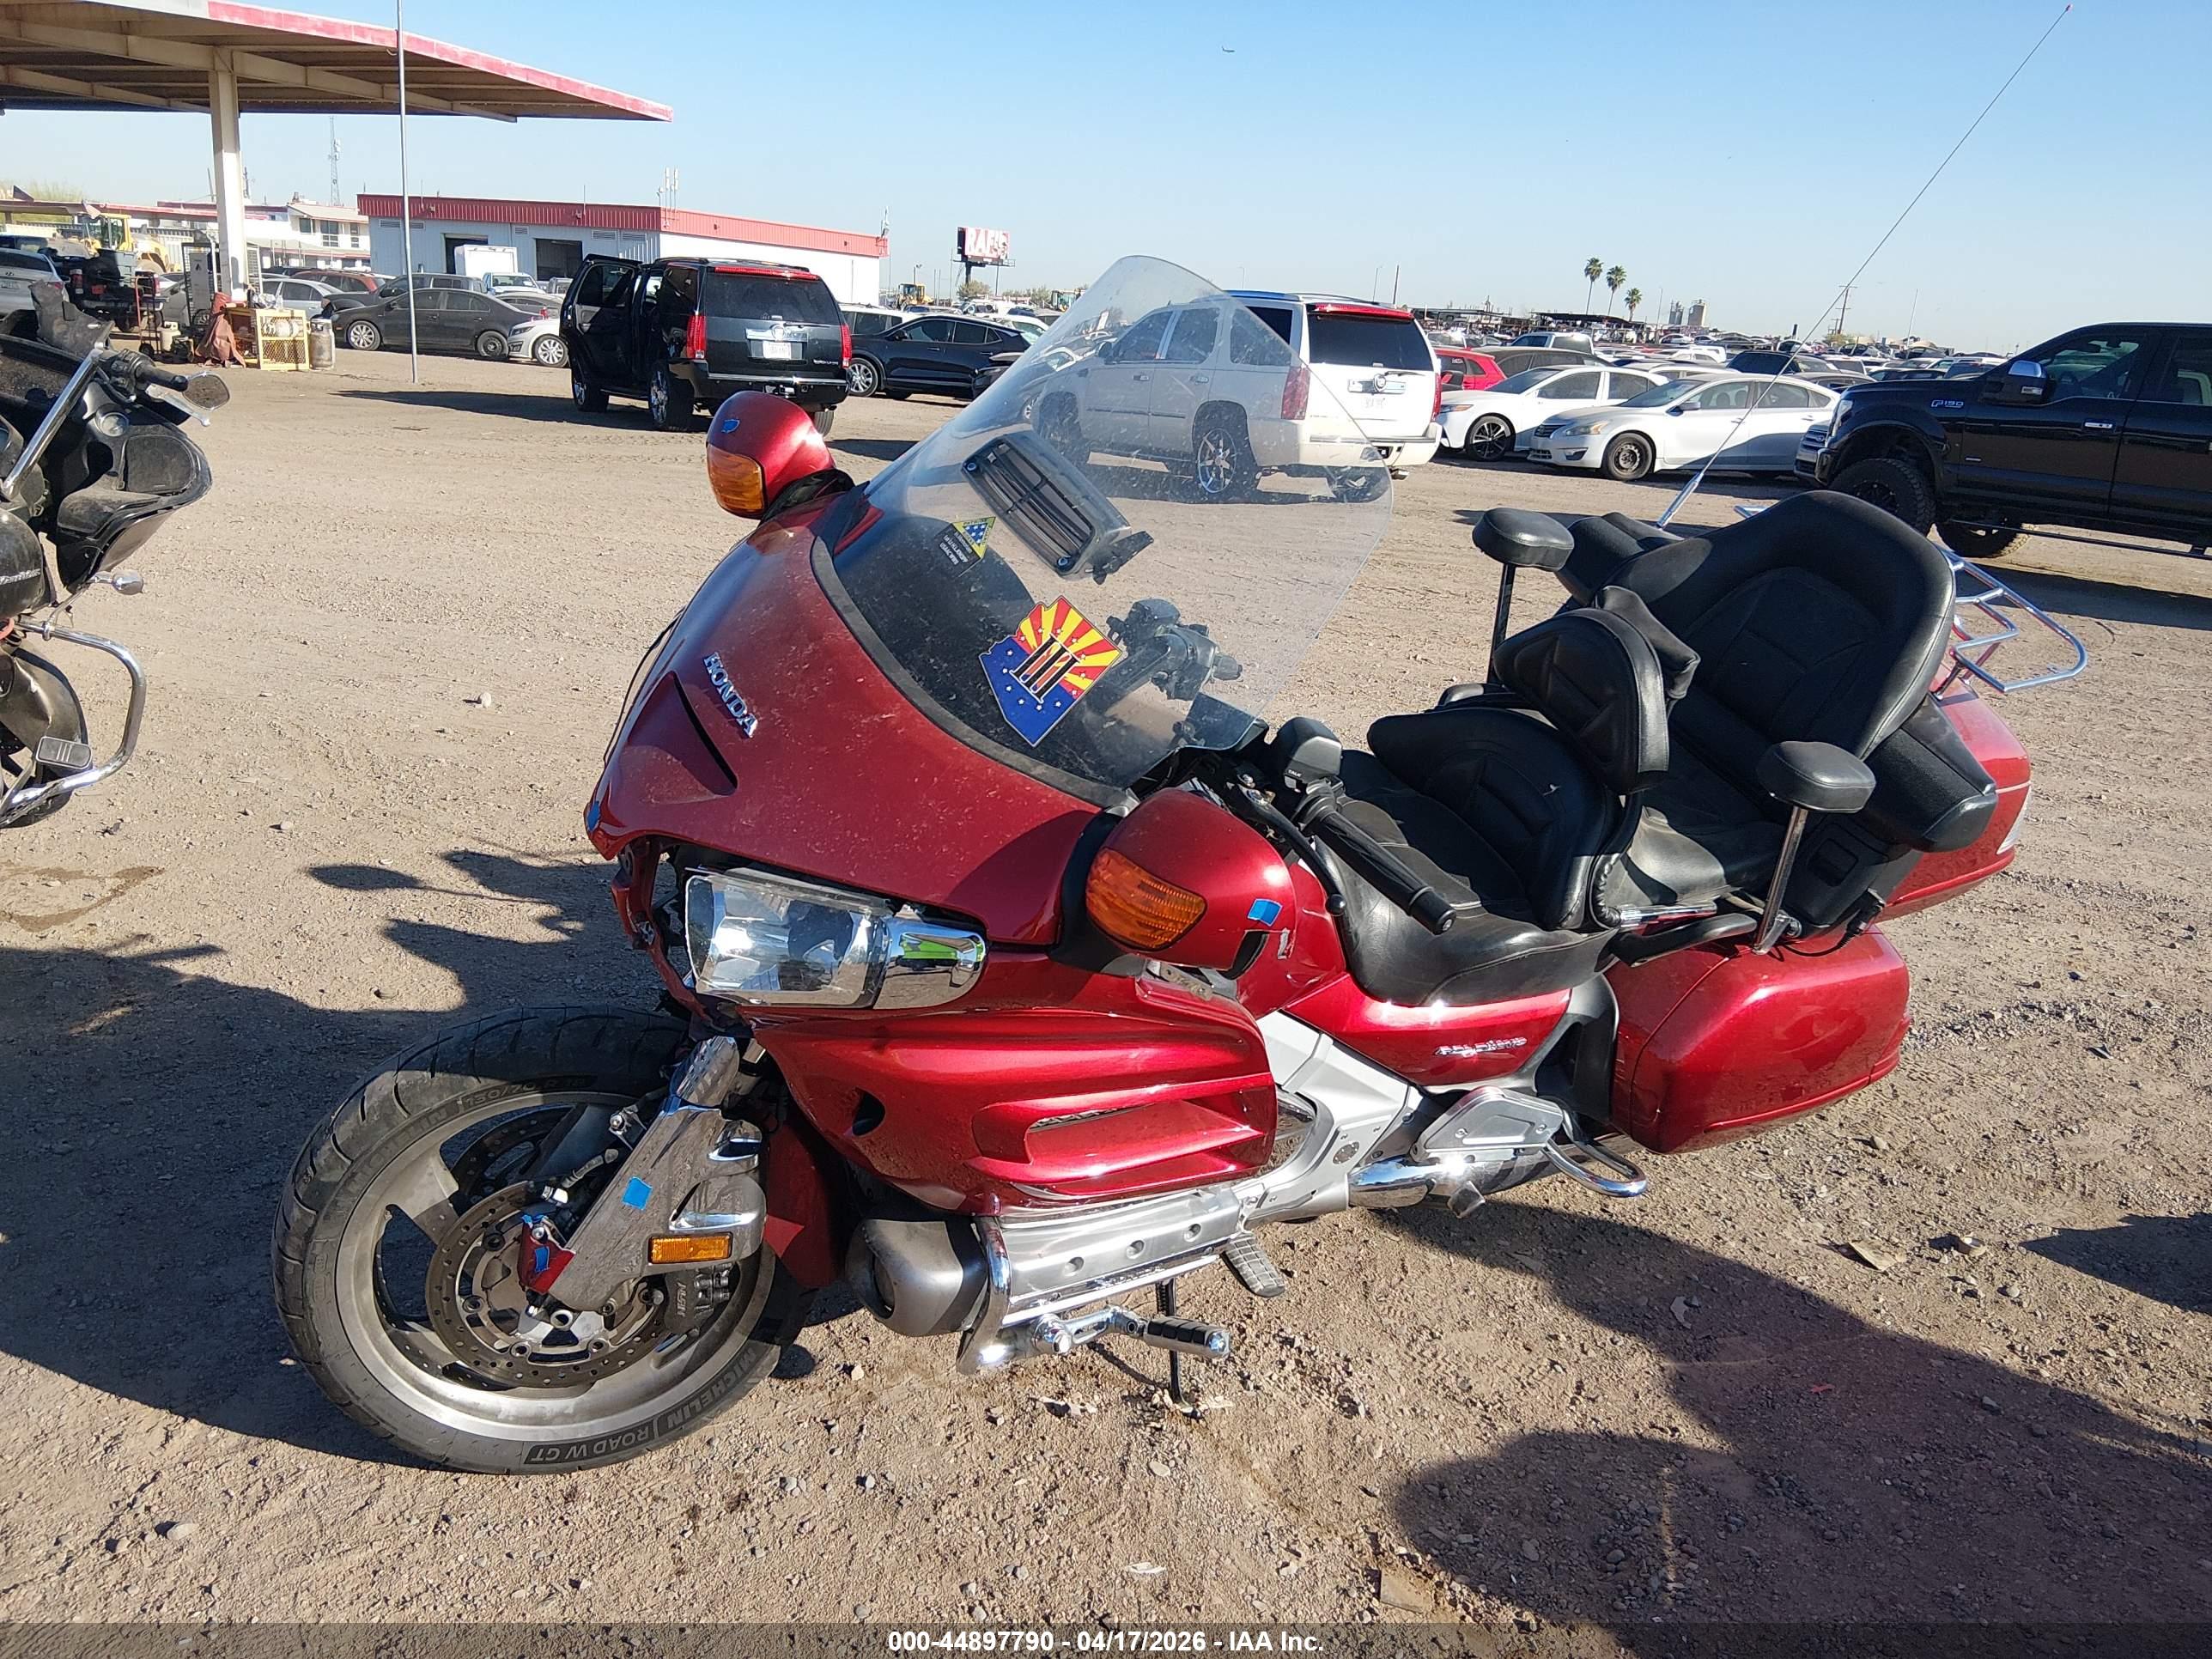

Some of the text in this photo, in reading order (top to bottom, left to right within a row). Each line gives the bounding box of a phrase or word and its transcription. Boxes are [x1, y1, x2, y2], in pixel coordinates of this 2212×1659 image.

[703, 651, 758, 738] HONDA
[531, 1346, 757, 1462] MICHELIN ROAD W GT
